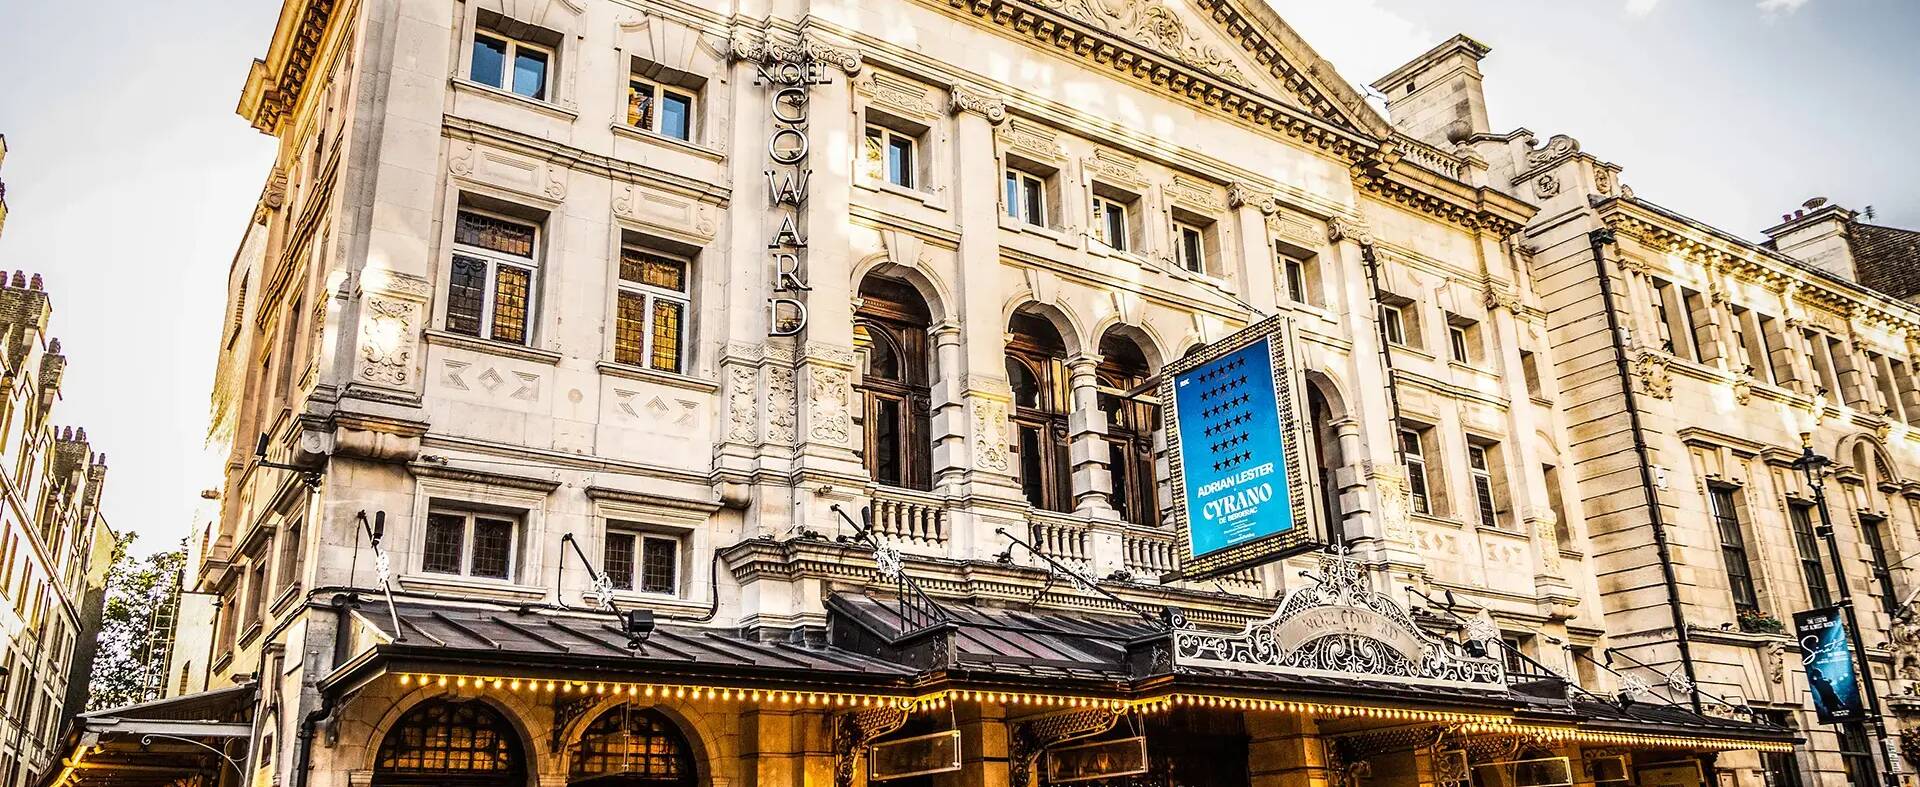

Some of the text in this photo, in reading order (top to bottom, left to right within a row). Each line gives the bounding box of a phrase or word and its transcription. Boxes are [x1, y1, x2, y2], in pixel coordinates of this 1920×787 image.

[753, 58, 832, 86] NOËL
[764, 87, 813, 338] COWARD
[1197, 462, 1274, 498] ADRIAN LESTER
[1203, 482, 1273, 520] CYRANO
[1218, 516, 1227, 525] DE
[1341, 609, 1398, 641] COWRD
